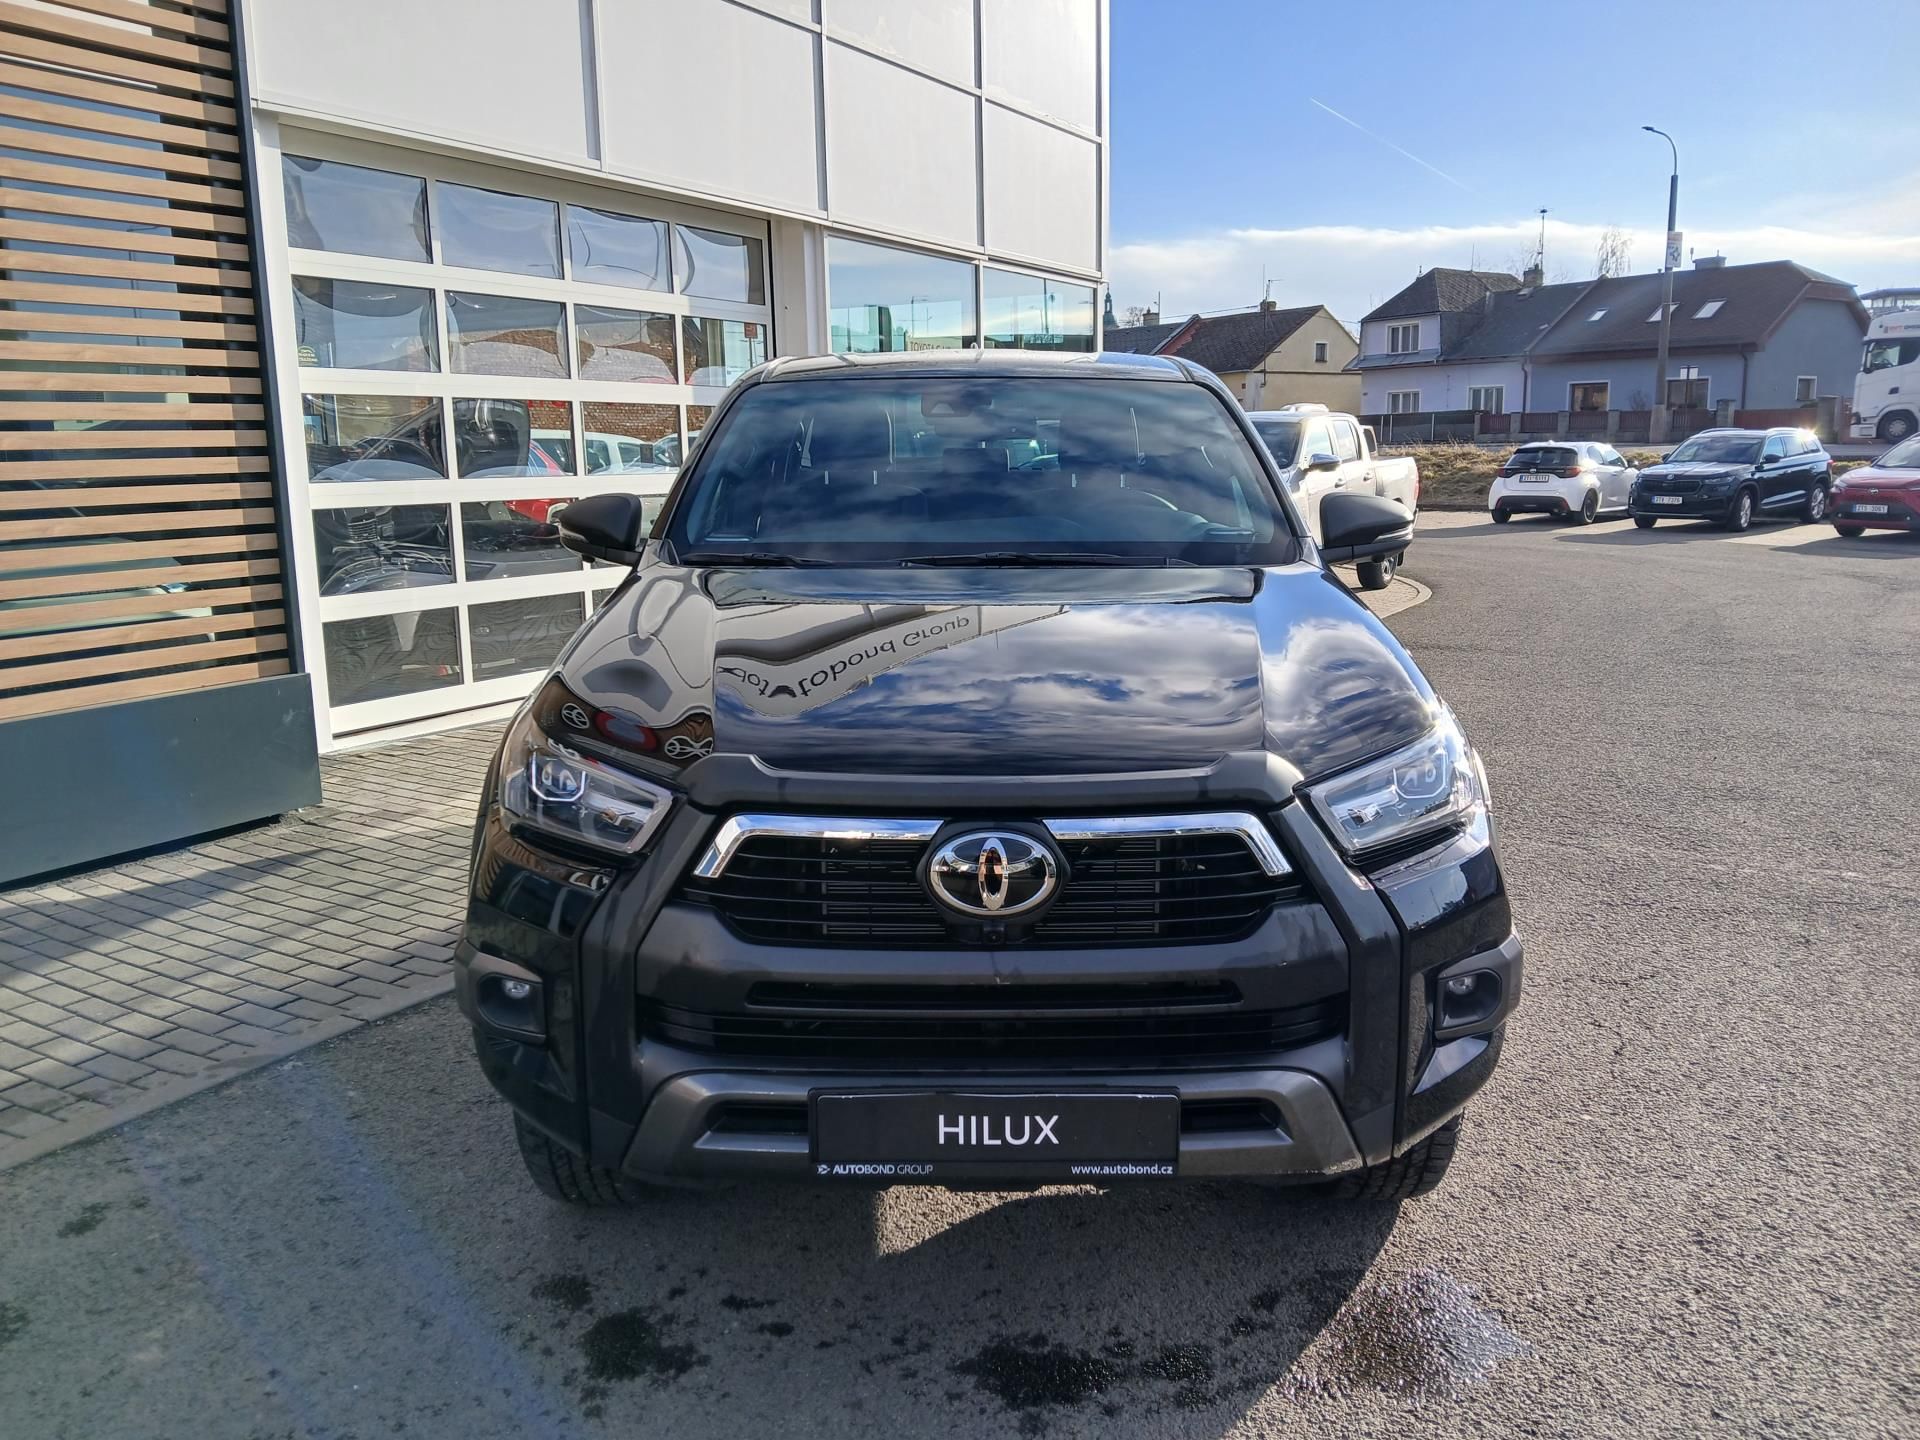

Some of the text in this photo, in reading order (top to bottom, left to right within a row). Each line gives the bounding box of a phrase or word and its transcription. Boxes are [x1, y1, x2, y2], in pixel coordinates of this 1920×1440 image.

[938, 1114, 1060, 1145] HILUX
[832, 1164, 934, 1175] AUTOBOND GROUP
[1071, 1163, 1173, 1175] www.autobond.cz
